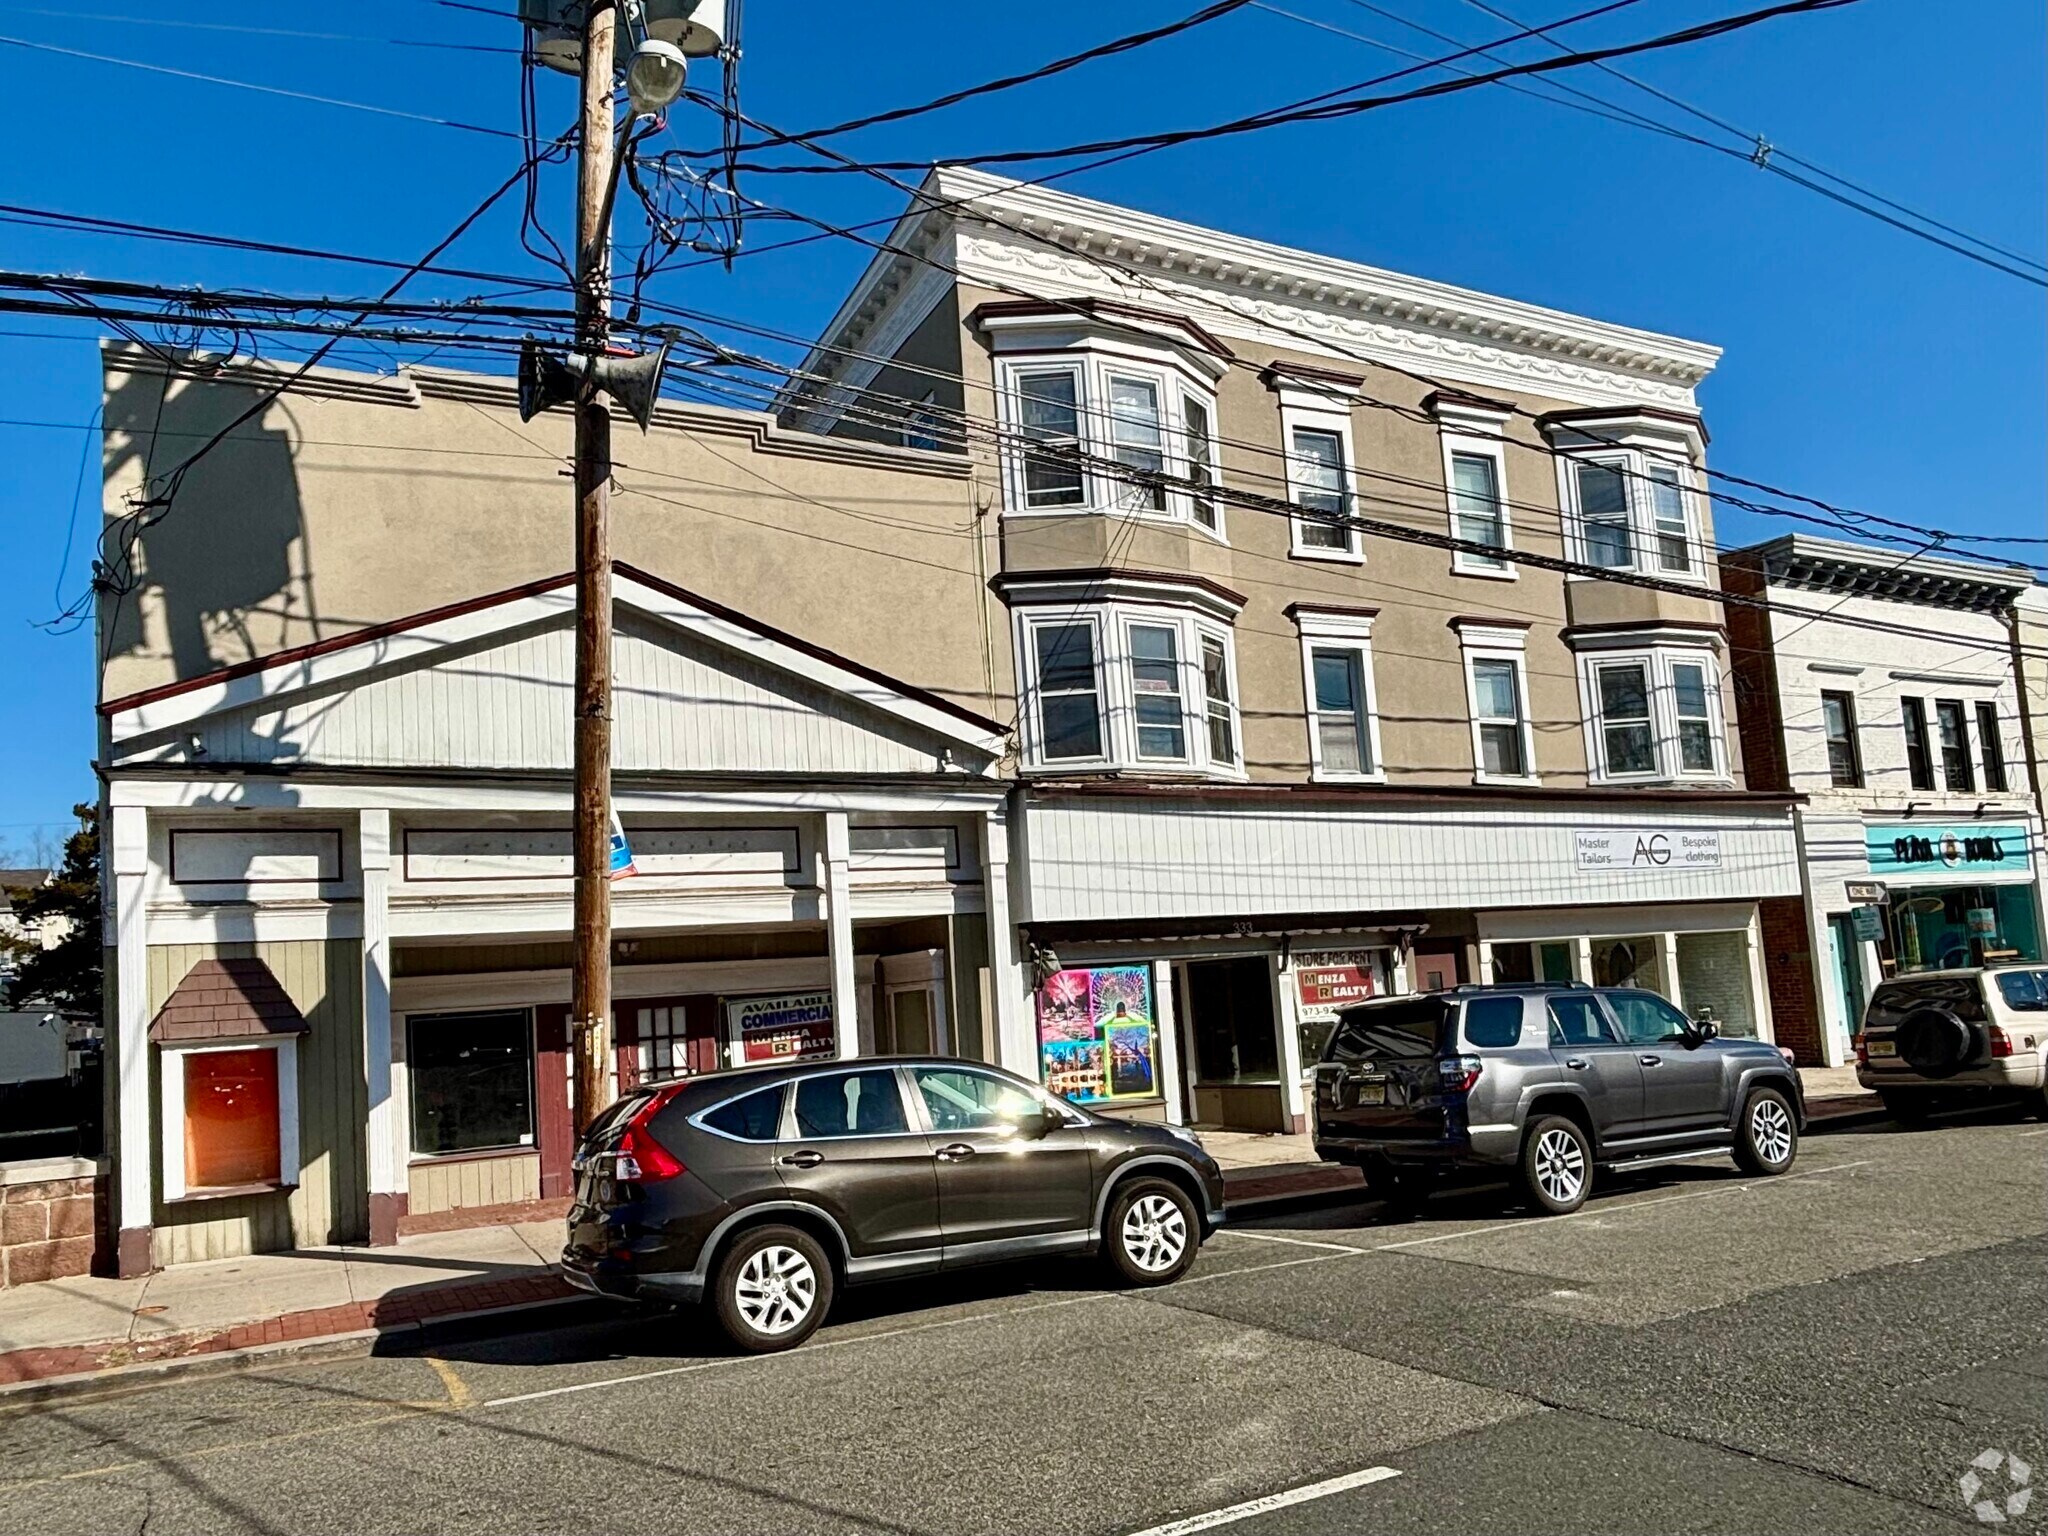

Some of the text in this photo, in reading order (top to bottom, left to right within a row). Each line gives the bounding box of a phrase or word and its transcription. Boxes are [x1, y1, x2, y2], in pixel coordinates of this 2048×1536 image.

[1578, 838, 1609, 849] Master
[1682, 836, 1717, 848] Bespoke
[1632, 834, 1671, 865] AG
[1581, 852, 1611, 864] Tailors
[1685, 851, 1719, 863] clothing
[1233, 922, 1253, 934] 333
[1296, 950, 1371, 967] STORE FOR RENT
[1304, 973, 1346, 985] MENZA
[1320, 986, 1367, 998] REALTY
[751, 1028, 811, 1044] MENZA
